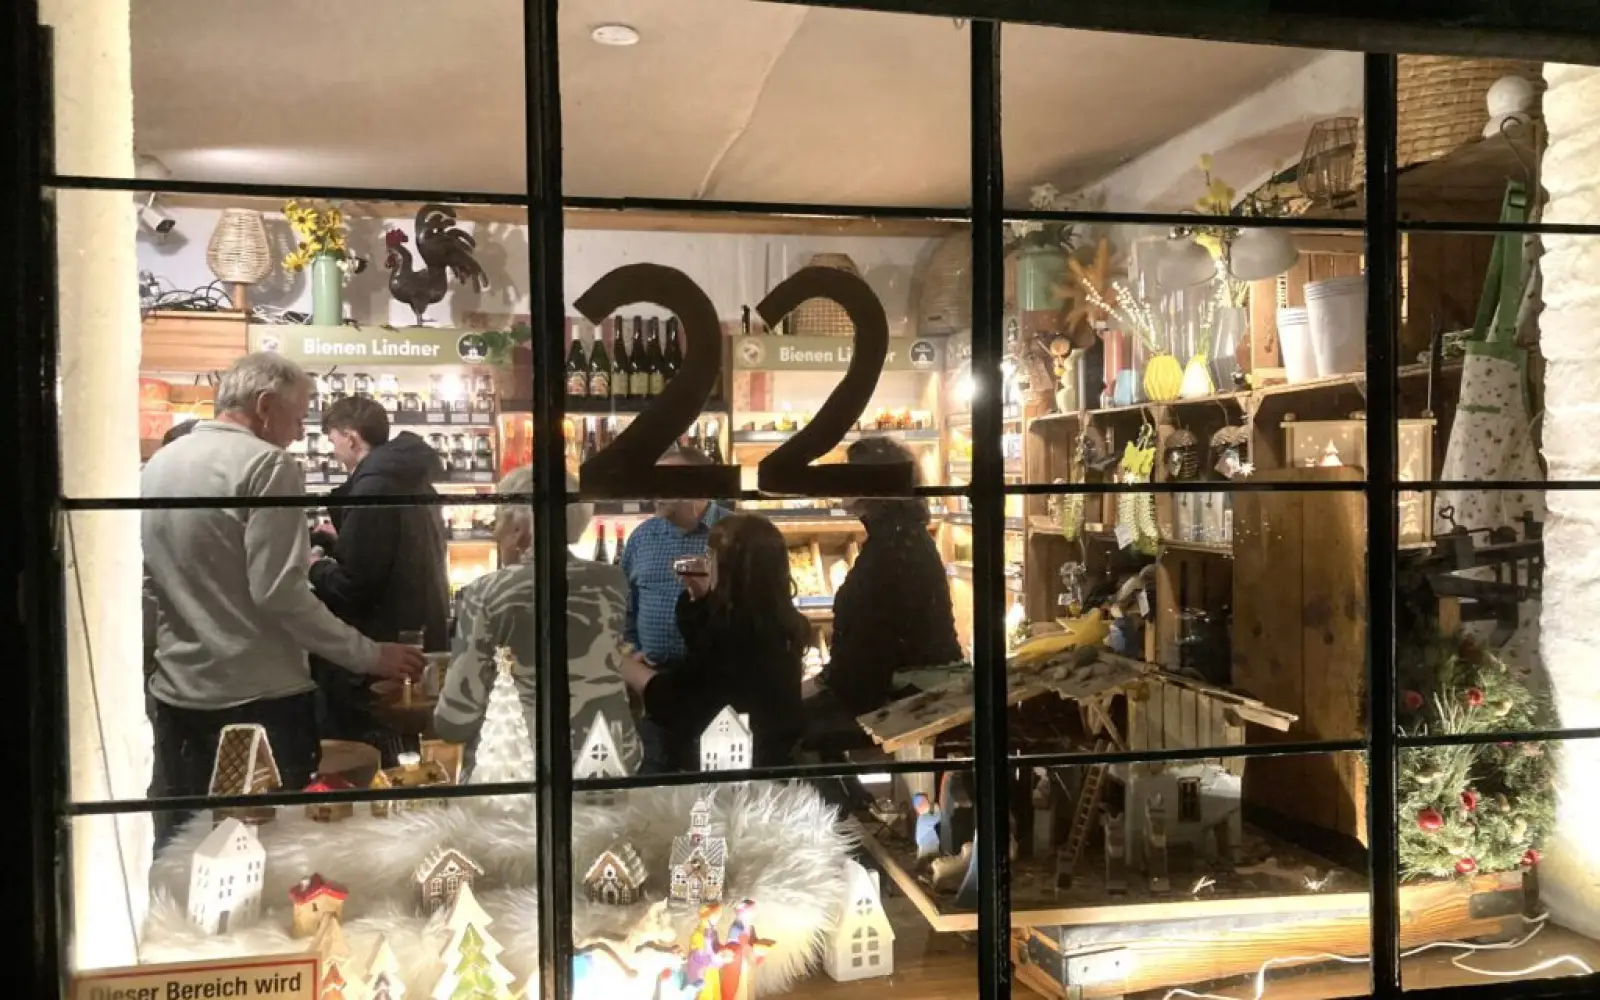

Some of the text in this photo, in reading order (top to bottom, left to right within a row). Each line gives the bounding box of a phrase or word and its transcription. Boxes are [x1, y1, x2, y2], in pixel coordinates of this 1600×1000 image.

[302, 337, 441, 357] Bienen Lindner
[779, 346, 834, 363] Bienen
[573, 262, 914, 498] 22
[89, 973, 302, 1000] Dieser Bereich wird
